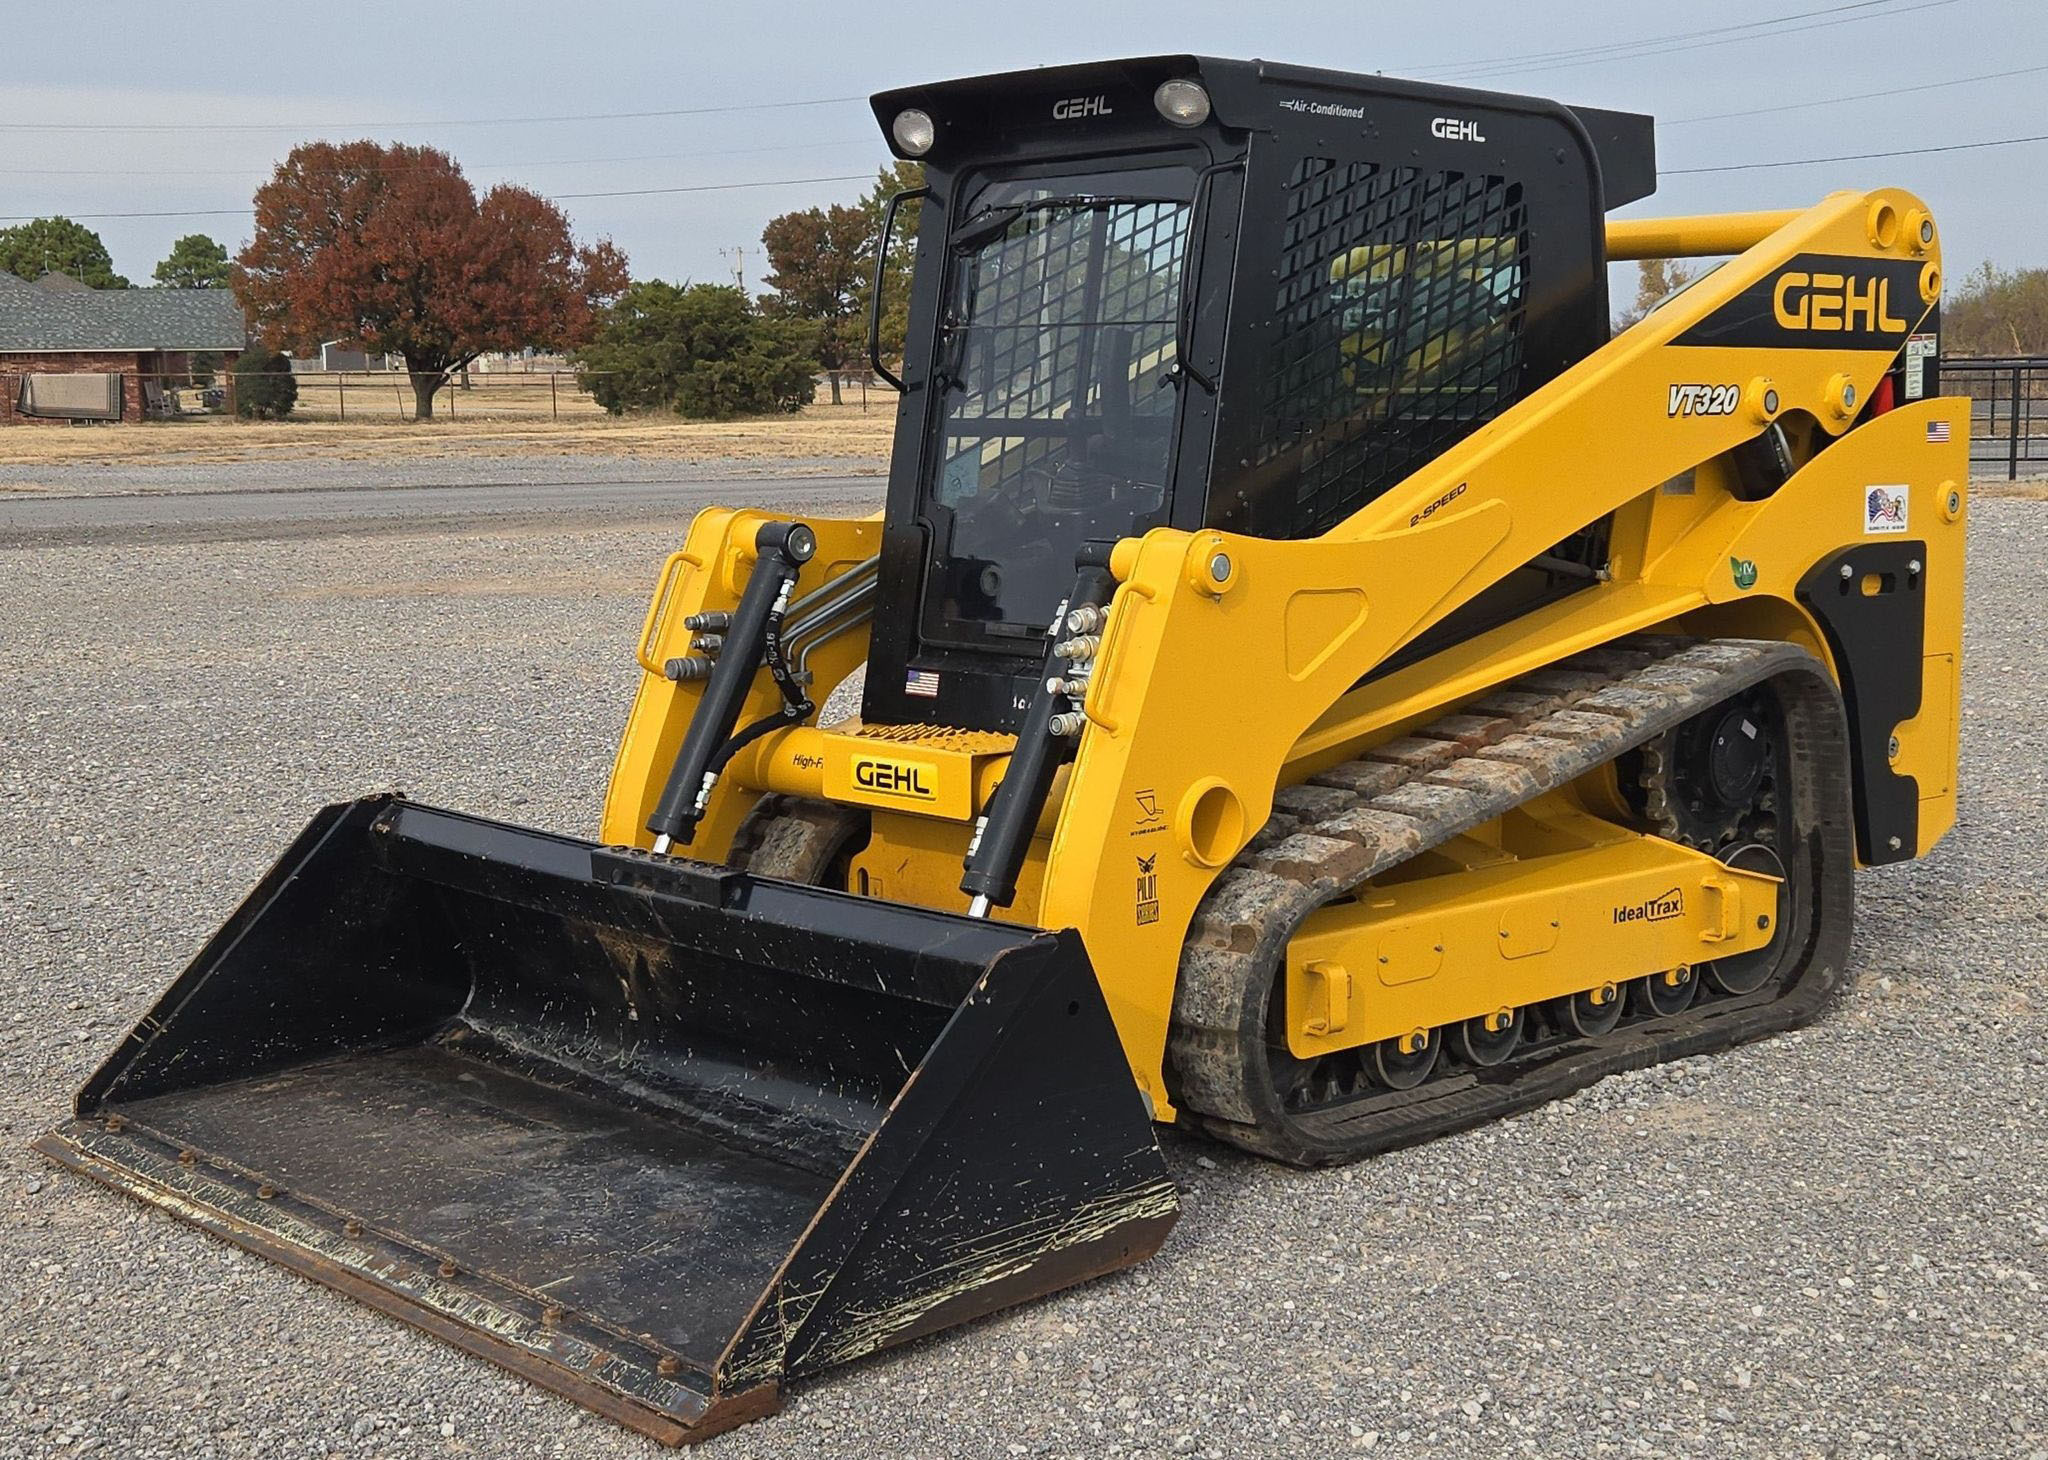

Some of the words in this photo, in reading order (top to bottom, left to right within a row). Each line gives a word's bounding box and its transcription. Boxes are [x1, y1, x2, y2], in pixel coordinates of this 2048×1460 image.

[1053, 95, 1113, 120] GEHL
[1293, 99, 1365, 119] Air-Conditioned
[1431, 117, 1486, 143] GEHL
[1774, 272, 1907, 333] GEHL
[1668, 384, 1741, 416] VT320
[1409, 482, 1467, 528] 2-SPEED
[856, 761, 930, 795] GEHL
[1136, 874, 1157, 903] PILOT
[1613, 899, 1680, 924] IdealTrax
